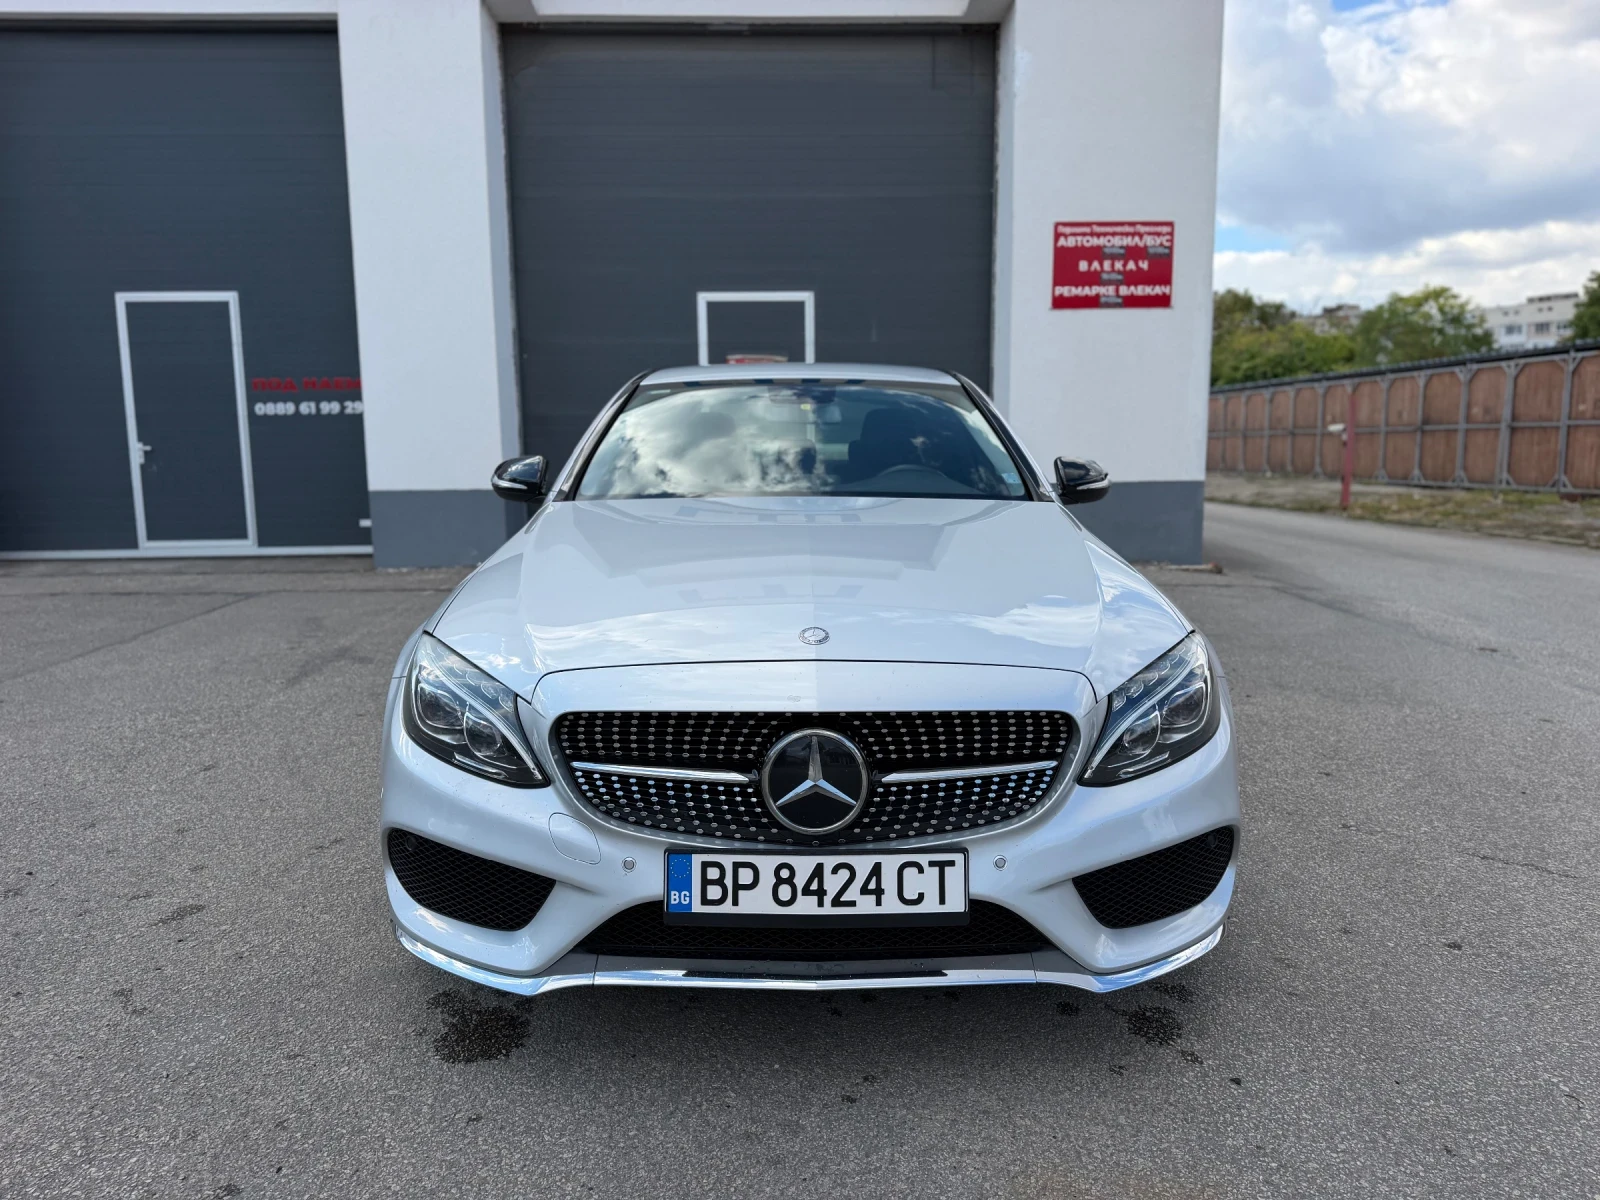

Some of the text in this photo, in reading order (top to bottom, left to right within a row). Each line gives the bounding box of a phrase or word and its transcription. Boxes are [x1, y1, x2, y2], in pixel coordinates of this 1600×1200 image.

[1078, 260, 1149, 272] ВЛЕКАЧ
[1054, 285, 1171, 297] РЕМАРКЕ ВЛЕКАЧ
[252, 377, 298, 393] ПОД
[254, 402, 296, 415] 0889
[299, 401, 317, 415] 61
[319, 401, 341, 414] 99
[700, 859, 956, 908] BP 8424 CT
[670, 890, 690, 905] BG
